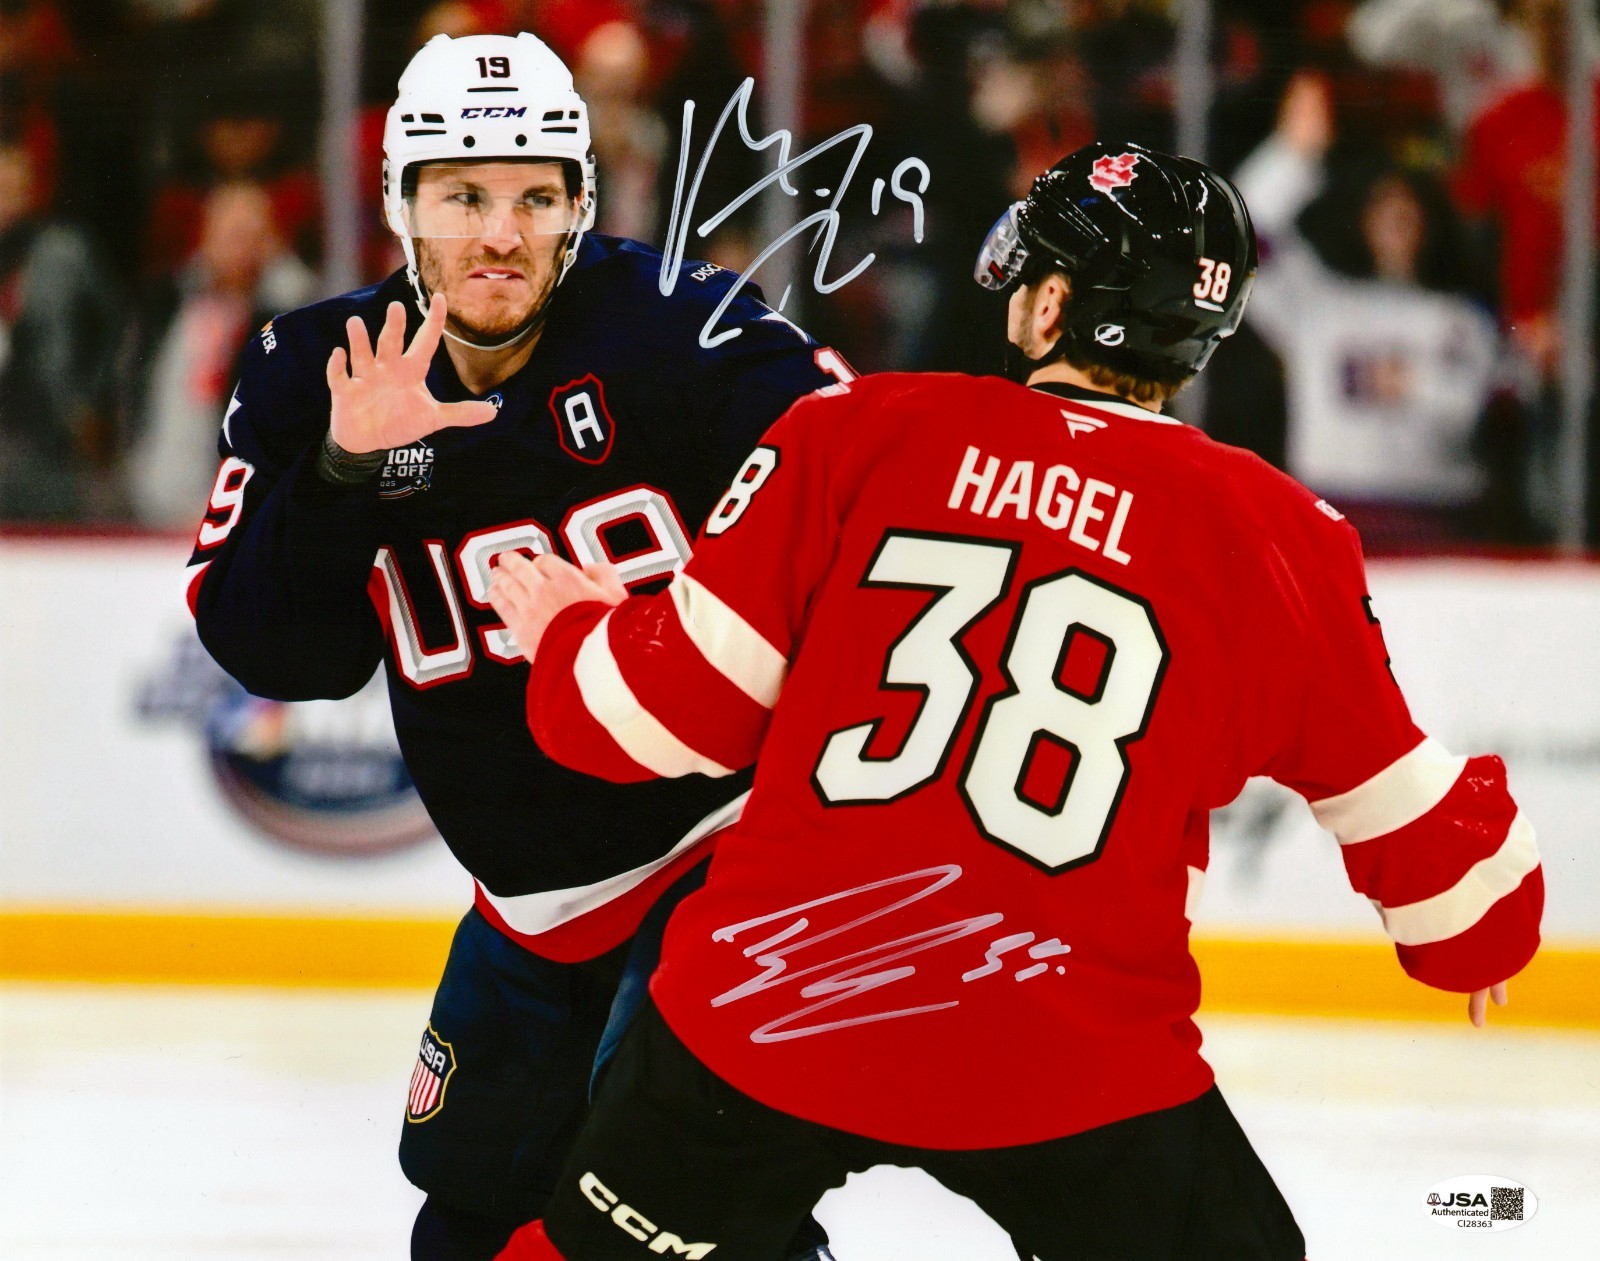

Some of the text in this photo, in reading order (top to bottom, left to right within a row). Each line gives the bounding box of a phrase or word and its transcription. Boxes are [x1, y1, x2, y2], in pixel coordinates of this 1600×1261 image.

[475, 56, 511, 78] 19
[460, 106, 528, 119] CCM
[871, 157, 931, 243] 19
[1193, 257, 1232, 303] 38
[564, 391, 604, 449] A
[704, 444, 781, 538] 8
[947, 444, 1134, 566] HAGEL
[810, 527, 1171, 877] 38
[420, 1033, 447, 1074] USA
[578, 1171, 718, 1261] CCM
[1431, 1207, 1489, 1217] Authenticated
[1441, 1192, 1489, 1208] JSA
